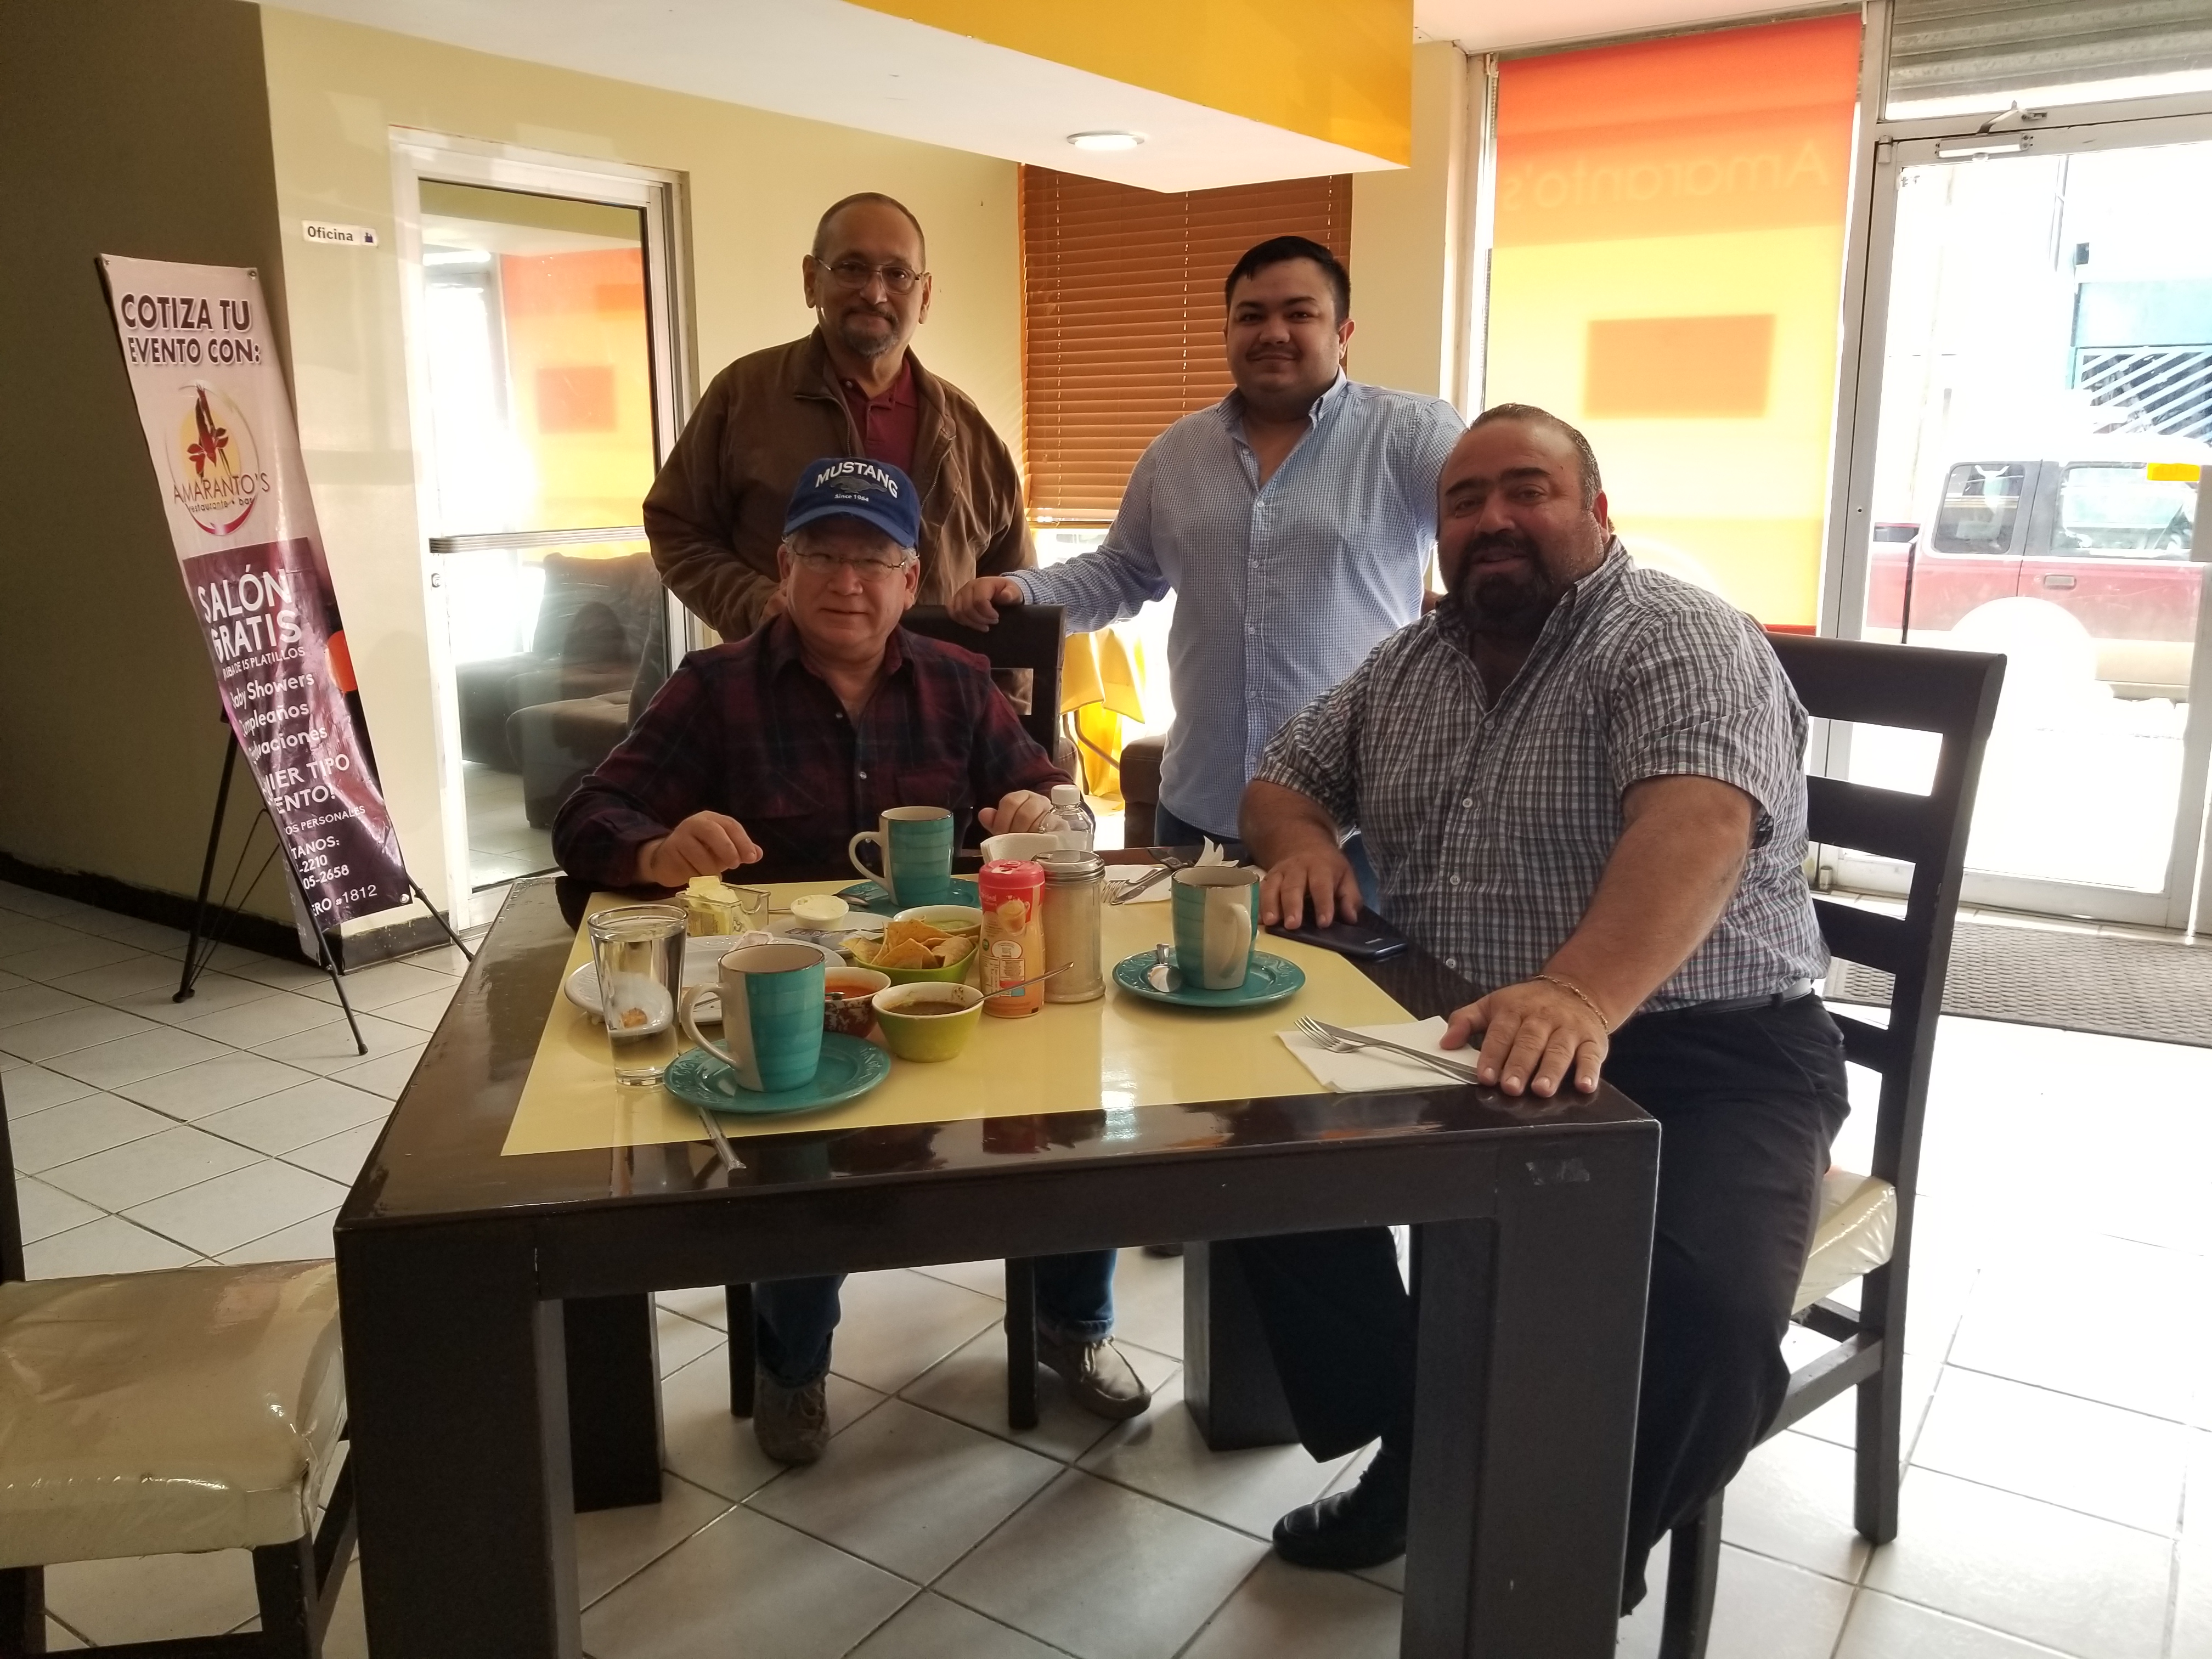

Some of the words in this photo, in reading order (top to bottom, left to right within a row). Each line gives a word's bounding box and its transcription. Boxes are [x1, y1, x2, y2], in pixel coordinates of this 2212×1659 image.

[307, 225, 353, 241] Oficina
[121, 293, 213, 330] COTIZA
[219, 300, 251, 331] TU
[127, 336, 201, 364] EVENTO
[208, 338, 261, 364] CON:
[173, 472, 270, 504] AMARANTO'S
[815, 461, 899, 499] MUSTANG
[189, 499, 228, 513] restaurante
[238, 497, 253, 506] bar
[198, 564, 292, 624] SALÓN
[211, 610, 302, 663] GRATIS
[241, 658, 250, 670] 15
[250, 646, 306, 668] PLATILLOS
[247, 674, 315, 700] Showers
[239, 703, 309, 737] umpleaños
[306, 753, 350, 779] TIPO
[274, 785, 336, 814] ENTO!
[285, 824, 300, 836] OS
[301, 805, 366, 831] PERSONALES
[290, 836, 340, 860] TANOS:
